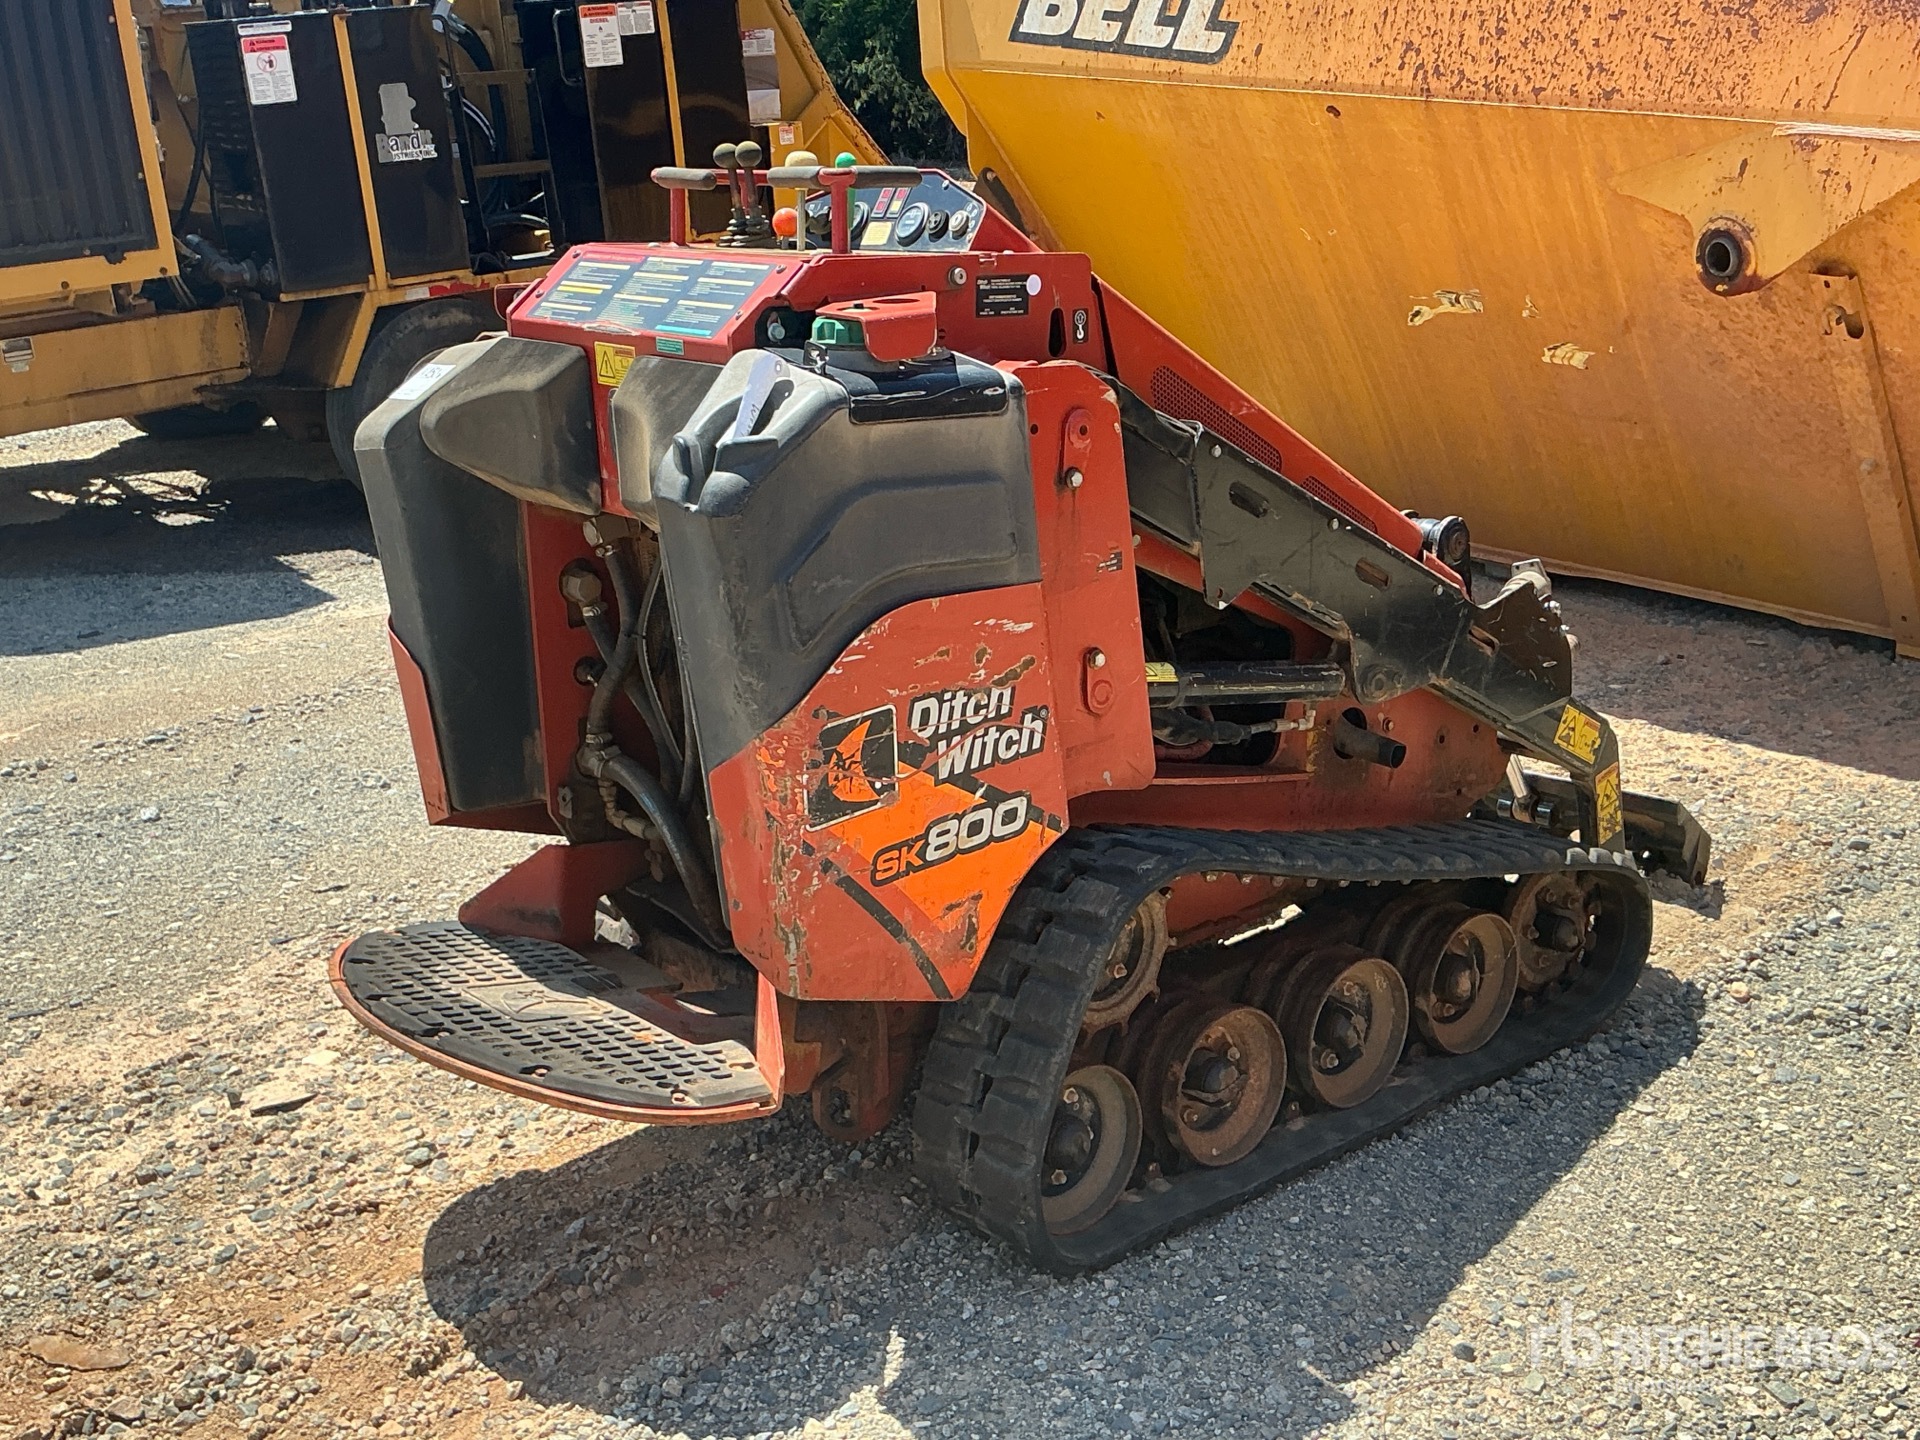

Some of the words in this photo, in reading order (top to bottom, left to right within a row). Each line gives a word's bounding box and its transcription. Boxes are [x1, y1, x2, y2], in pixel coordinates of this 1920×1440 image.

[1017, 0, 1229, 54] BELL
[911, 687, 1012, 739] Ditch
[873, 795, 1030, 882] SK800
